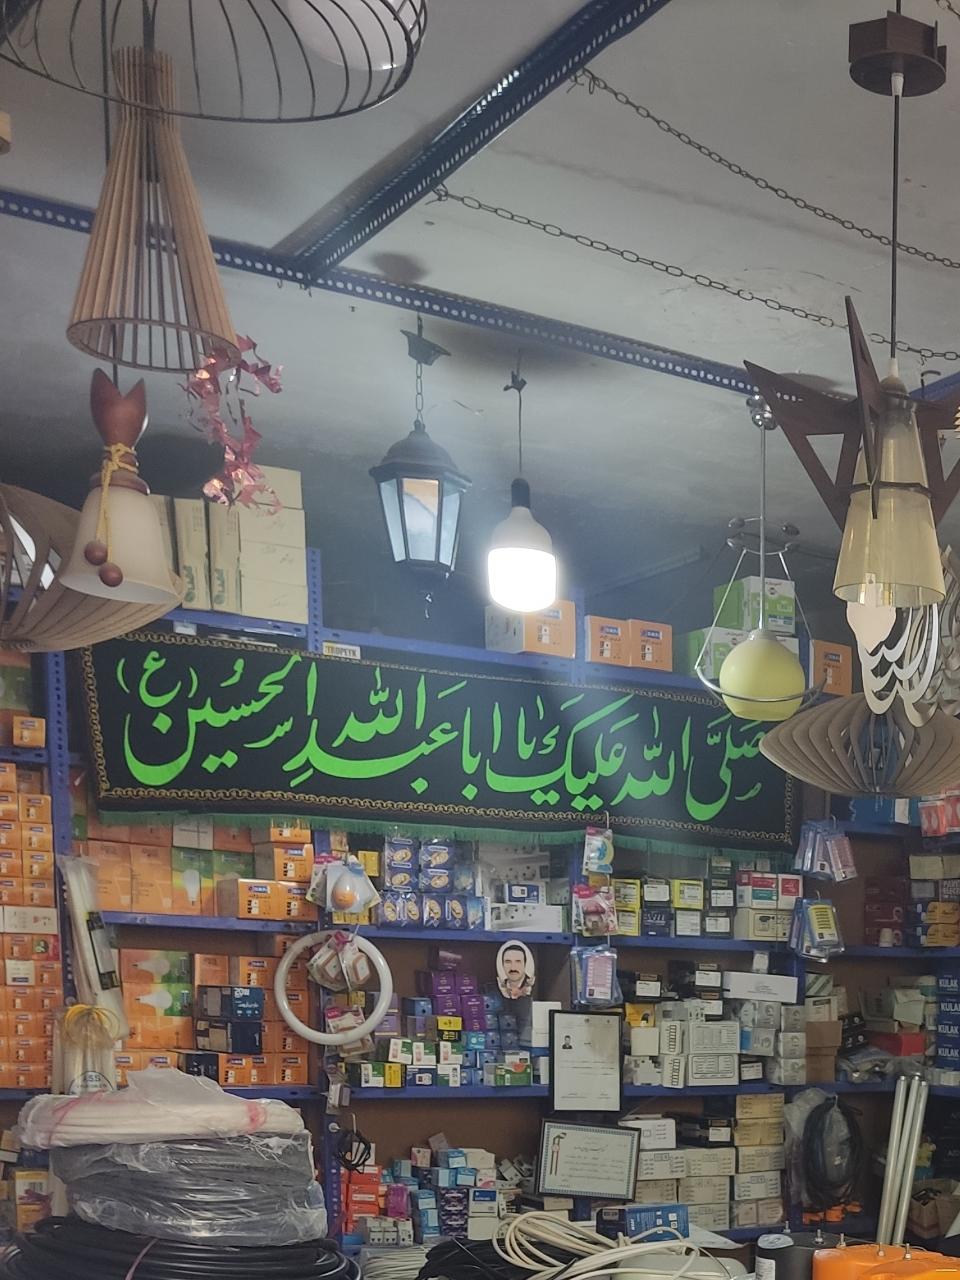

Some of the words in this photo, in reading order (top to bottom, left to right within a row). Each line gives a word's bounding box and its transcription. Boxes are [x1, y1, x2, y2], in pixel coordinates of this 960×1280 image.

[939, 978, 958, 988] KULAK
[938, 1024, 959, 1034] KULAK
[938, 1047, 960, 1058] KULAK
